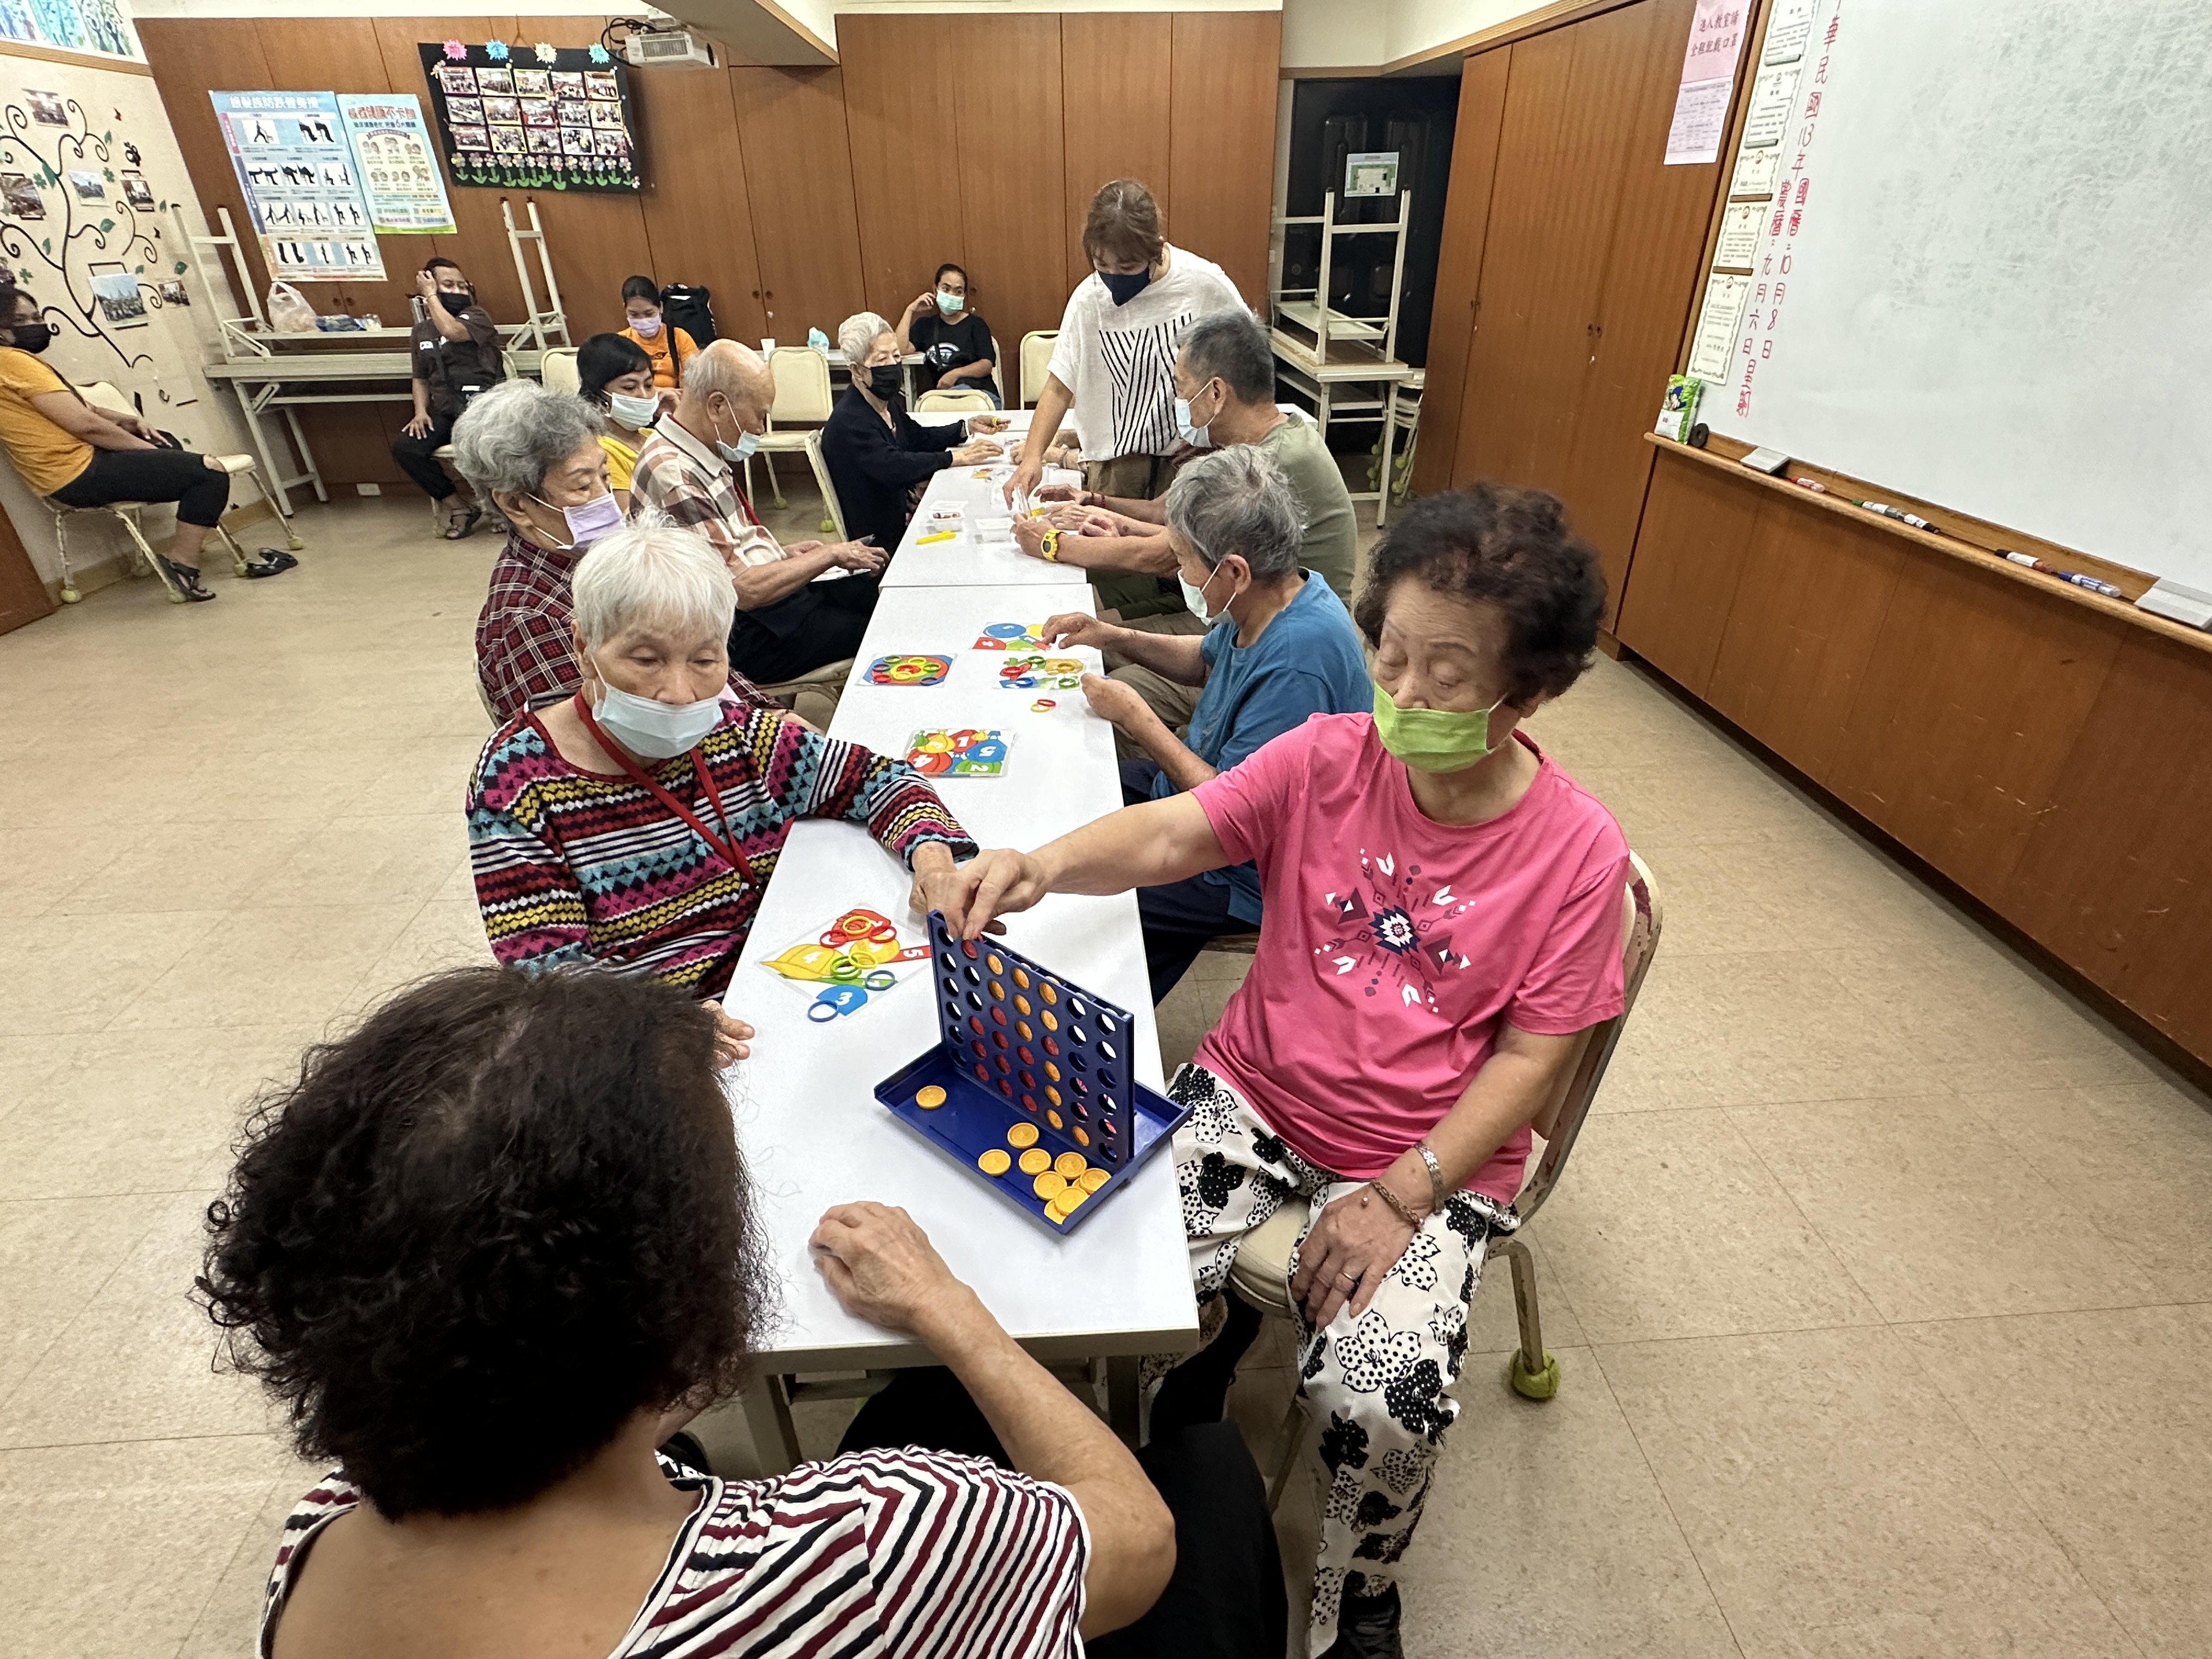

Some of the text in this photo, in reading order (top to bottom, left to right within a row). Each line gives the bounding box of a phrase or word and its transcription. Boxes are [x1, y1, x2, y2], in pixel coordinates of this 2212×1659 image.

[1791, 0, 1841, 180] 華民國113年
[803, 951, 823, 964] 4
[903, 949, 924, 958] 5
[835, 992, 853, 1006] 3
